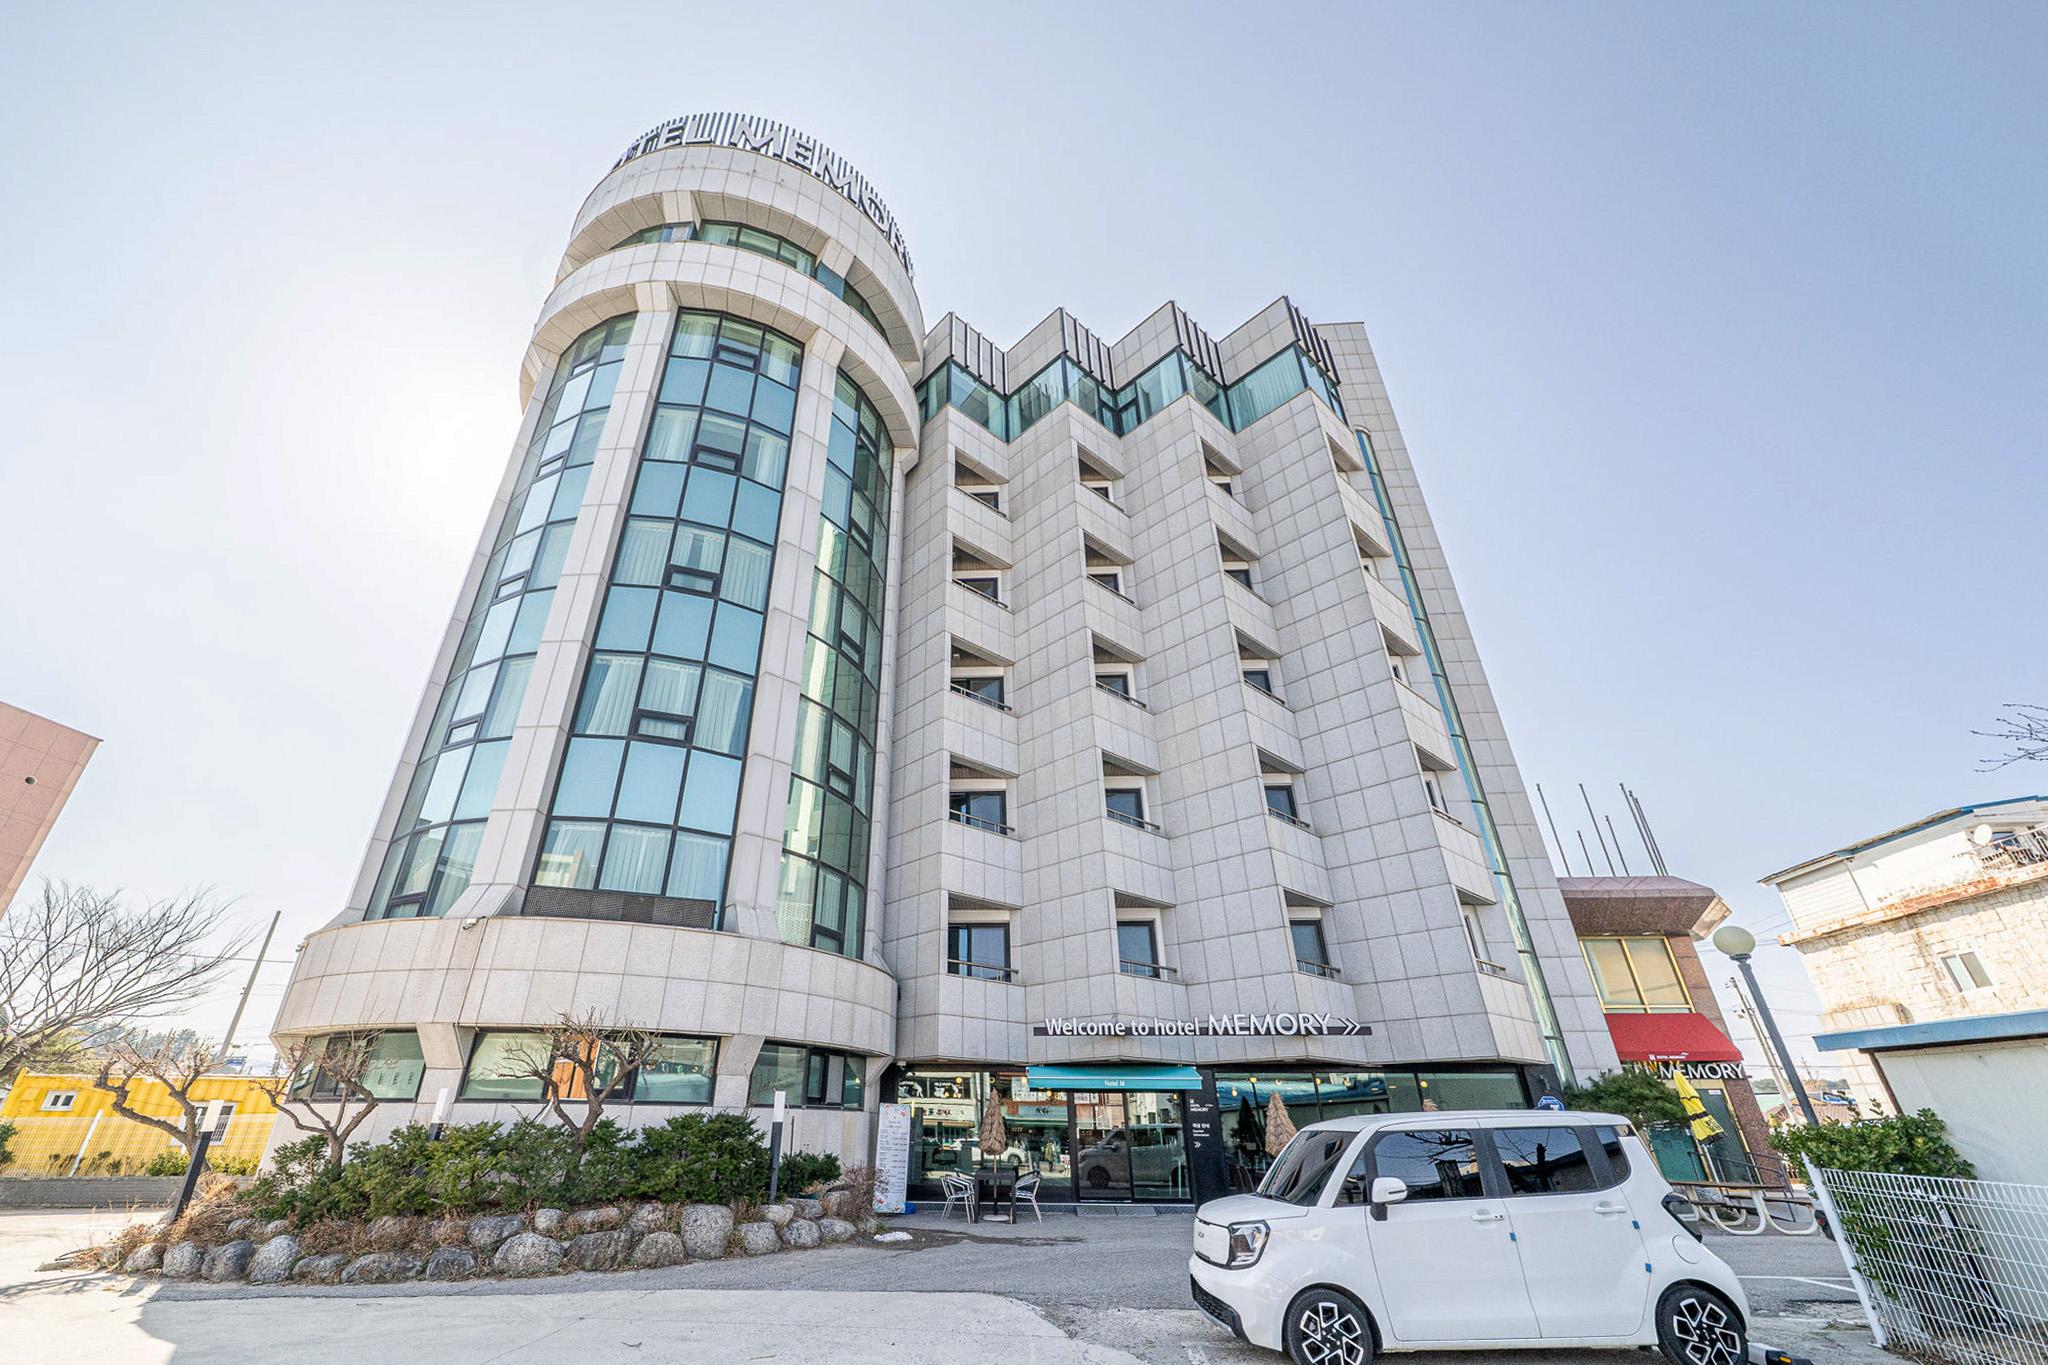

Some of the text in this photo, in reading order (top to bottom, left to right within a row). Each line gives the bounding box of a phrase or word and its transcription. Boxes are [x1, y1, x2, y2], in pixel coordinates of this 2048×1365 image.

[612, 117, 712, 170] TEL
[1045, 1012, 1331, 1037] Welcome to hotel MEMORY
[1659, 1062, 1743, 1078] MEMORY
